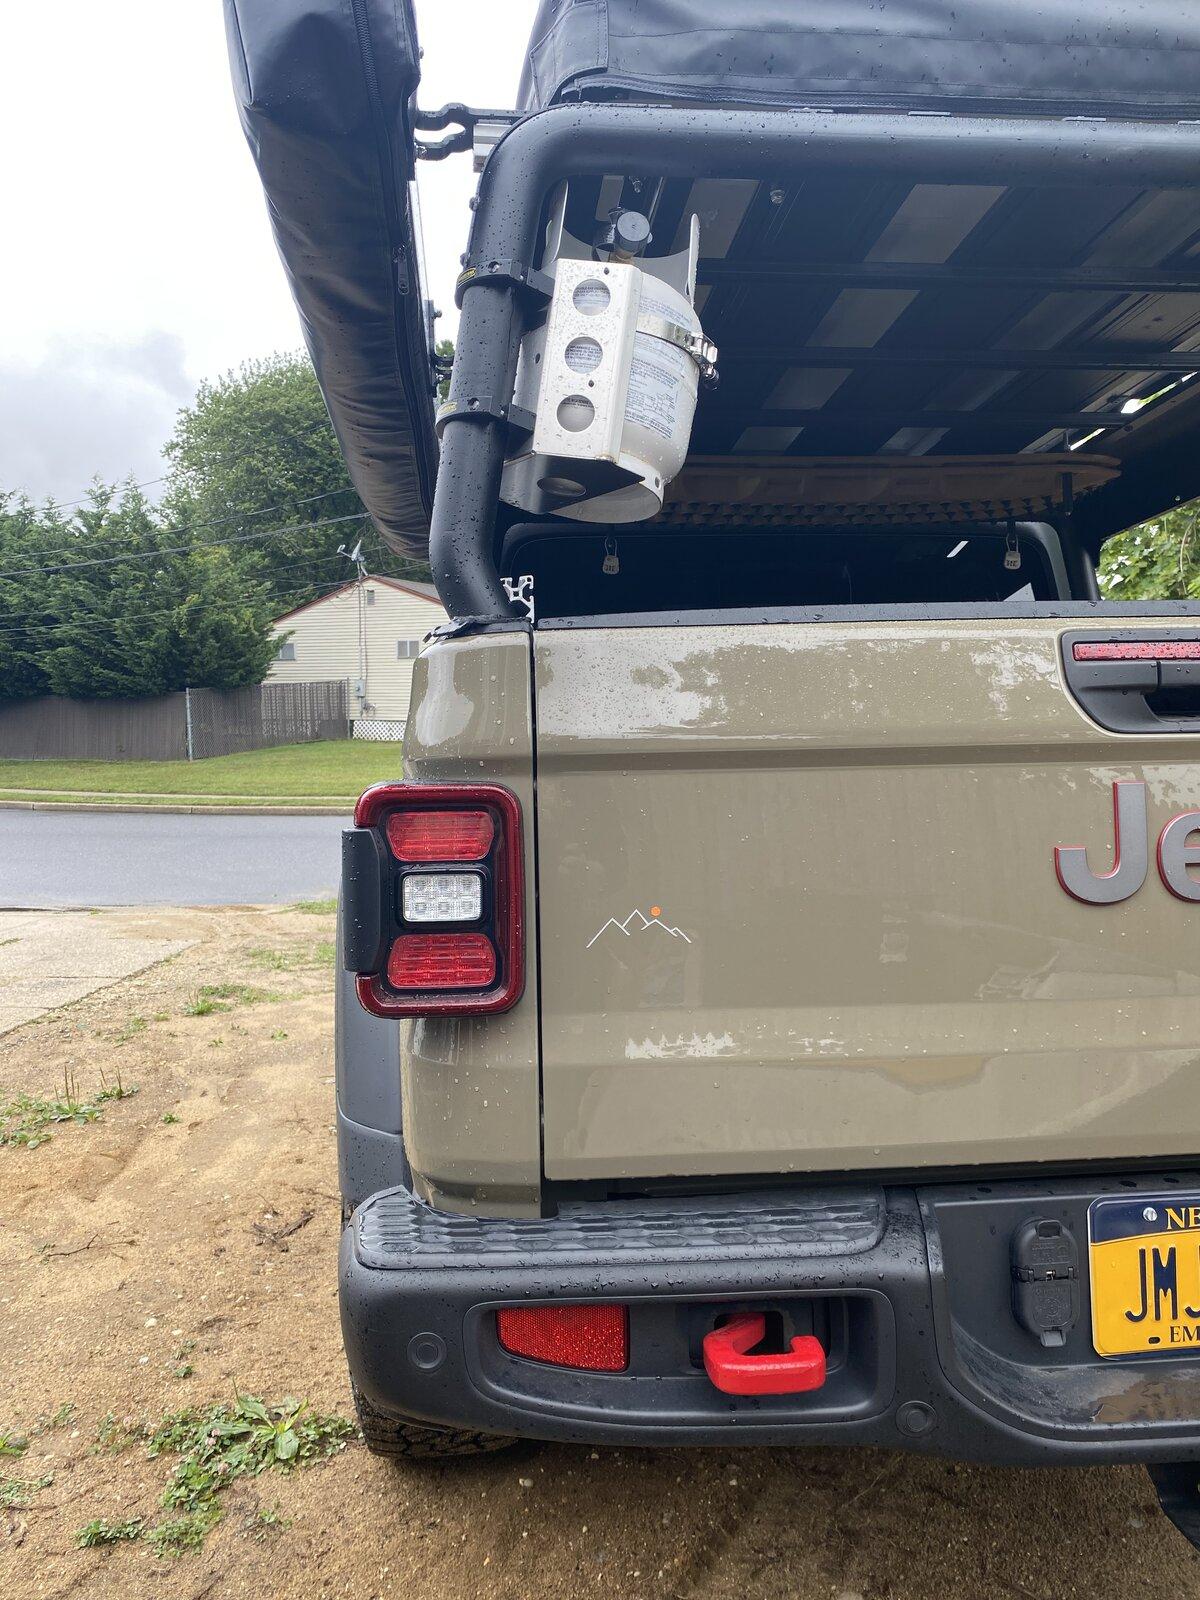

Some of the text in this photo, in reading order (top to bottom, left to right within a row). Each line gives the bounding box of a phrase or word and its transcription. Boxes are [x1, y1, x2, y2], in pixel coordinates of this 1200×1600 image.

[1054, 779, 1200, 906] Je
[1164, 1206, 1200, 1230] NE
[1169, 1325, 1200, 1343] EM
